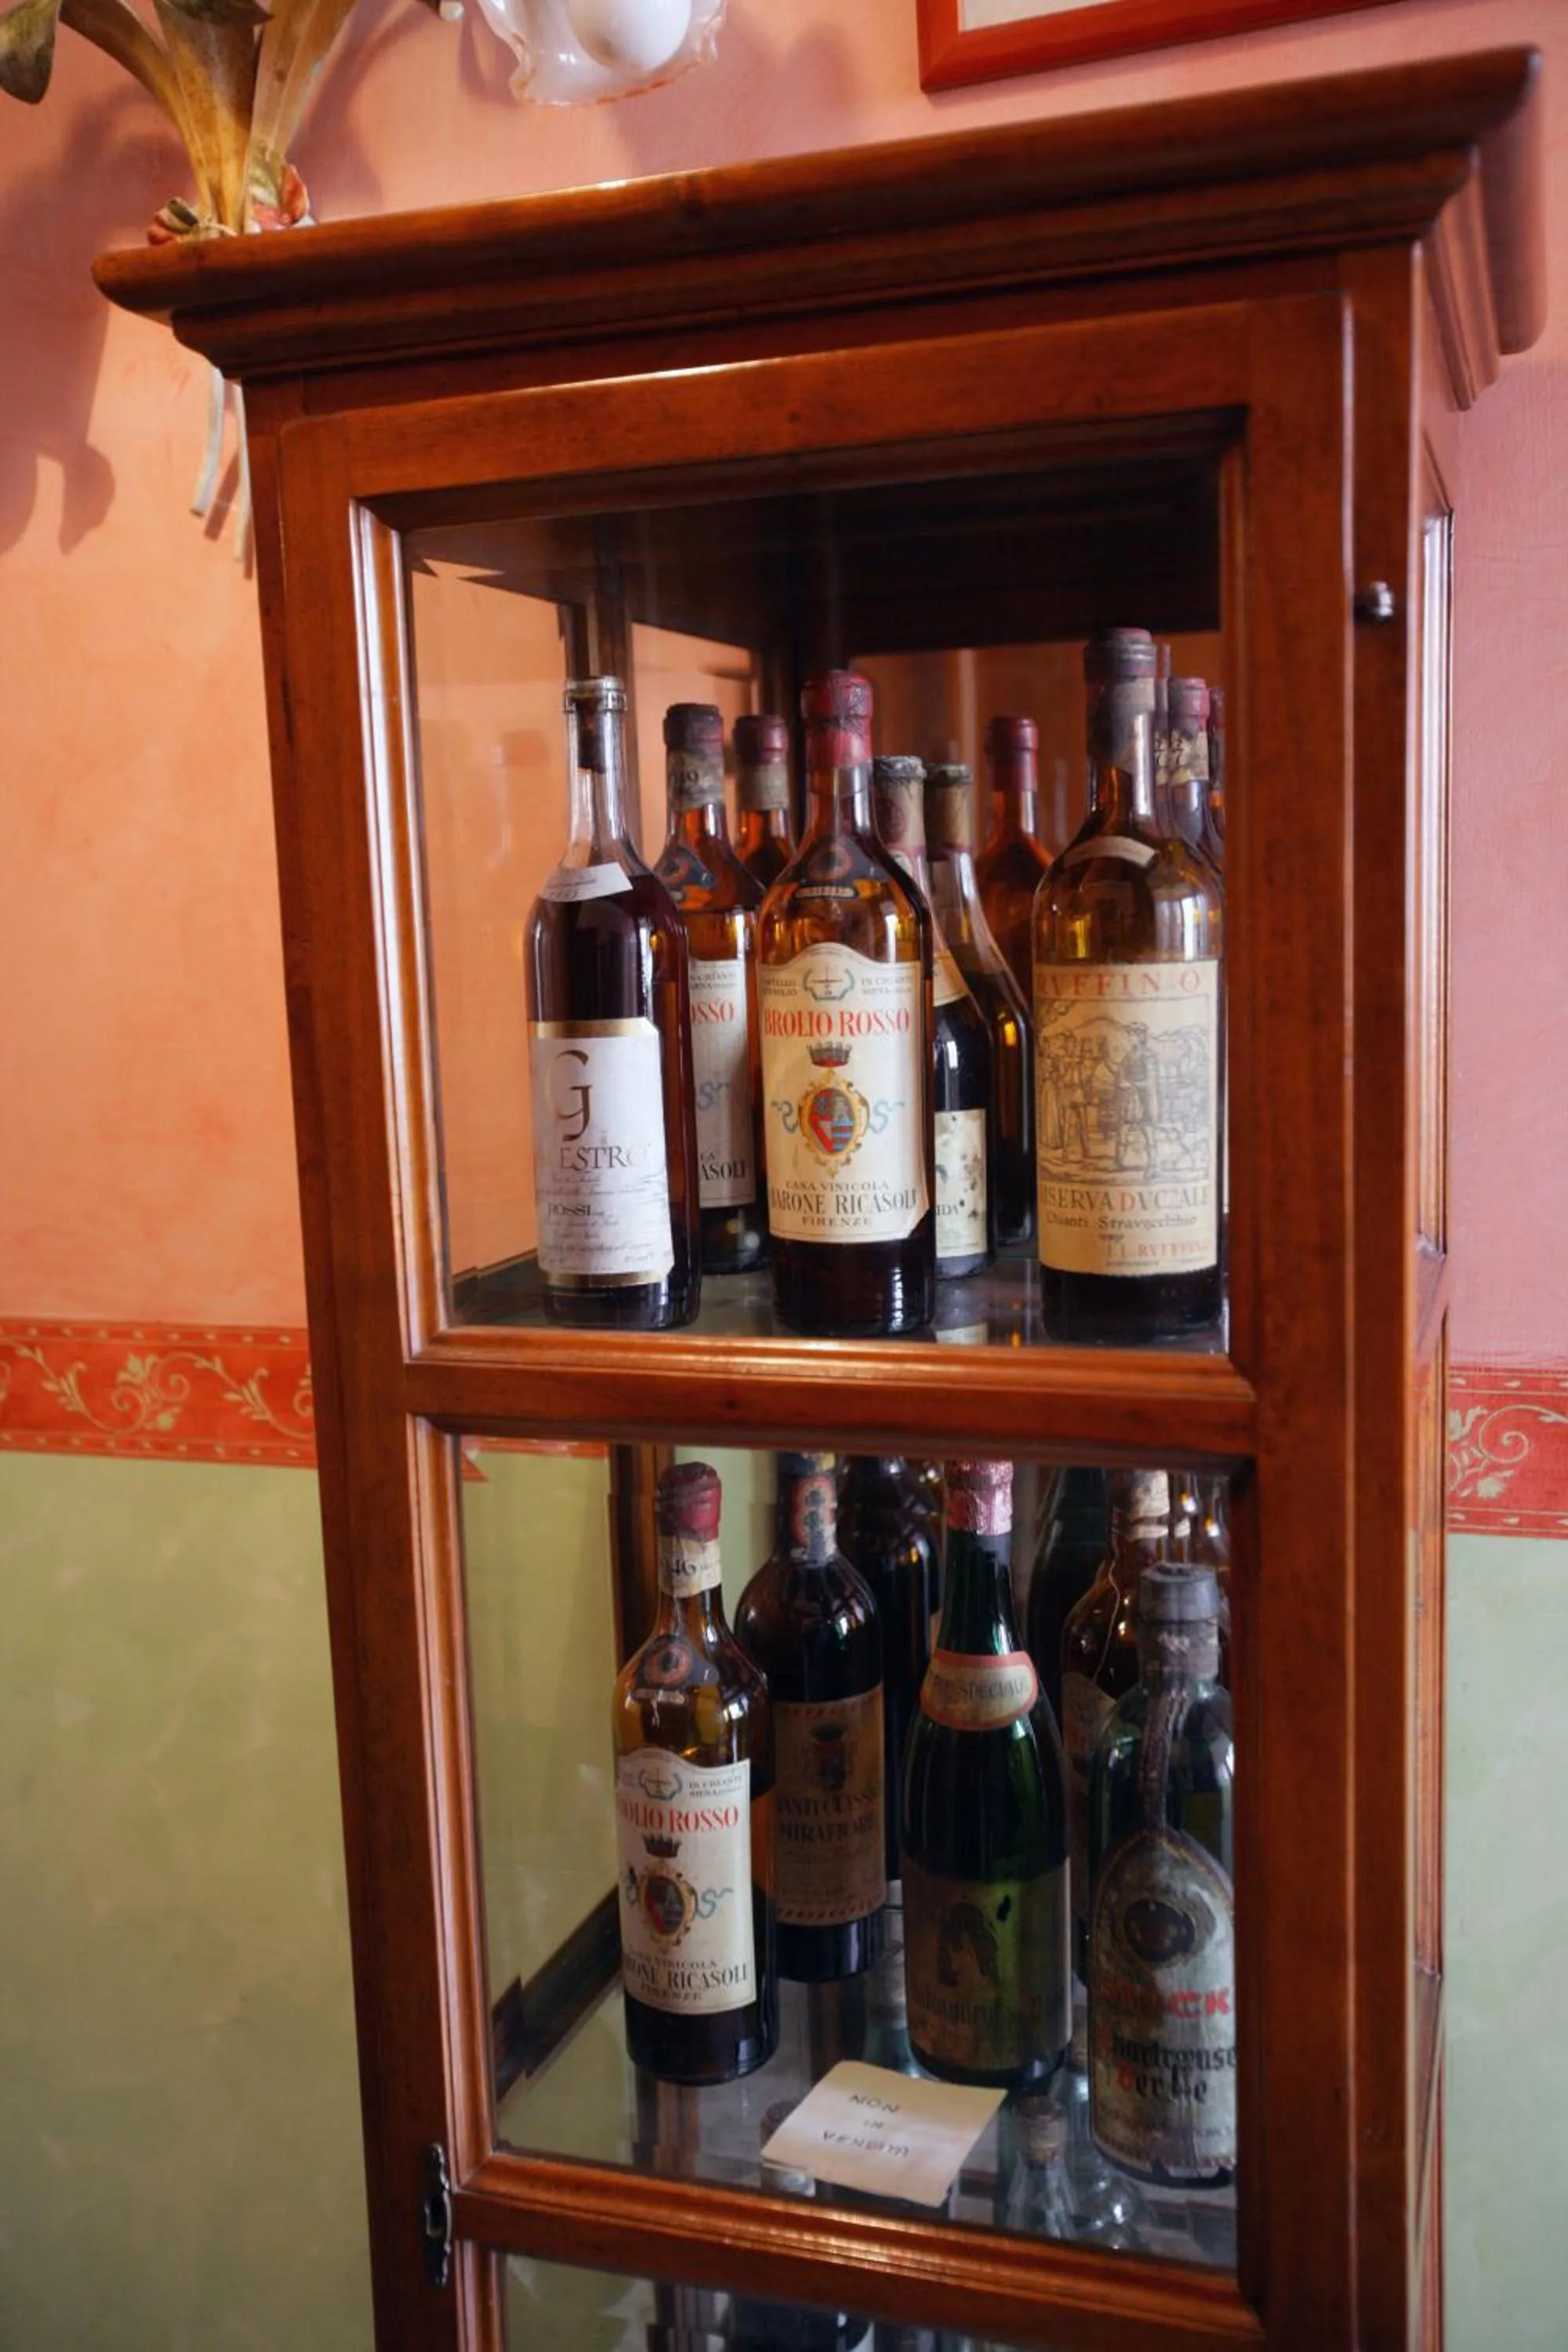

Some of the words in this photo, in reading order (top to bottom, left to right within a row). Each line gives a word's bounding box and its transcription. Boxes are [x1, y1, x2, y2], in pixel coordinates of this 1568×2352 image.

[764, 1008, 833, 1037] BROLIO
[840, 1007, 910, 1037] ROSSO
[786, 1179, 816, 1192] CASA
[823, 1179, 889, 1192] VINICOLA
[835, 1189, 917, 1214] RICASOLI
[801, 1217, 873, 1228] FIRENZE
[668, 1806, 739, 1833] ROSSO
[667, 1962, 748, 1990] RICASOLI
[848, 2093, 902, 2114] NON
